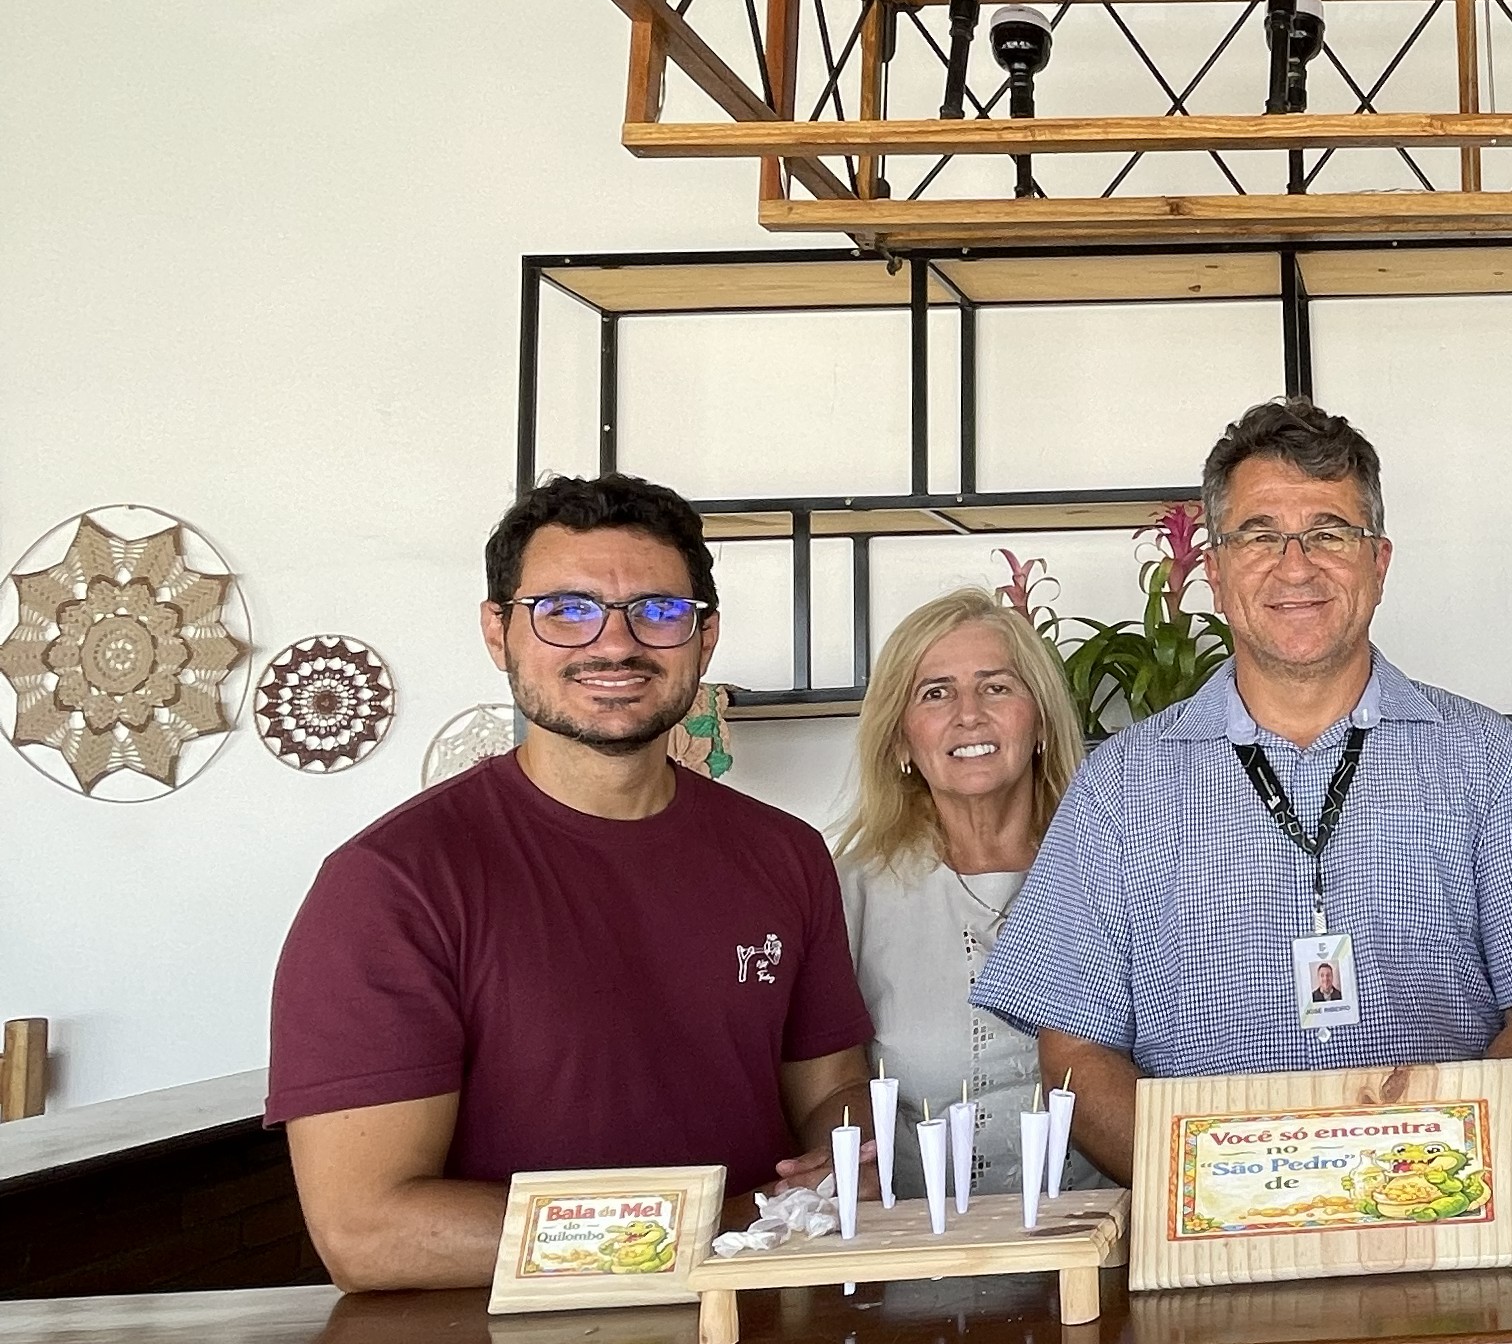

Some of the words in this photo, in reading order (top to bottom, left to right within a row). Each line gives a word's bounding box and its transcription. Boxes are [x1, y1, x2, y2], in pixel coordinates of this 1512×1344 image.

[1209, 1130, 1273, 1146] Você
[1279, 1127, 1309, 1142] só
[1314, 1121, 1442, 1139] encontra
[1266, 1144, 1298, 1155] no
[1264, 1175, 1300, 1190] de
[546, 1204, 596, 1222] Bala
[619, 1201, 664, 1219] Mel
[563, 1221, 581, 1230] do
[537, 1230, 605, 1244] Quilombo
